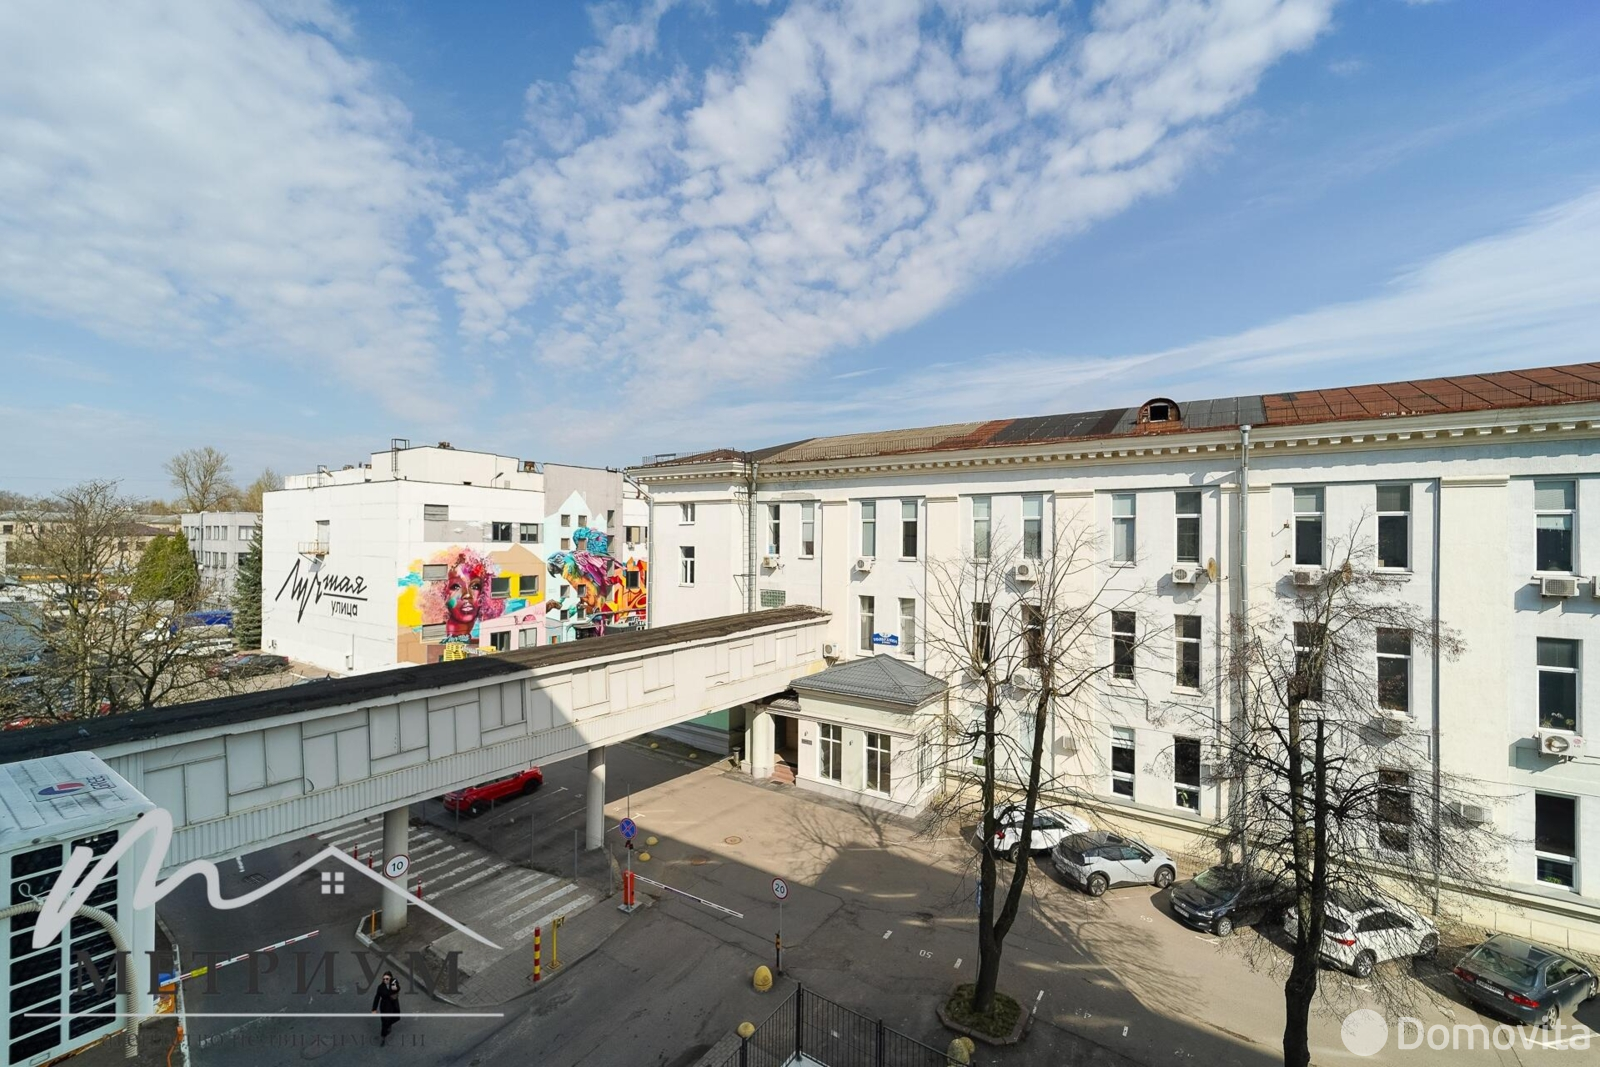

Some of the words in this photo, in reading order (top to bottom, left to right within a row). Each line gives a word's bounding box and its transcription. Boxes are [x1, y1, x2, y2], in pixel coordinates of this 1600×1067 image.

[331, 600, 358, 617] улица
[391, 861, 404, 872] 10
[774, 883, 785, 894] 20
